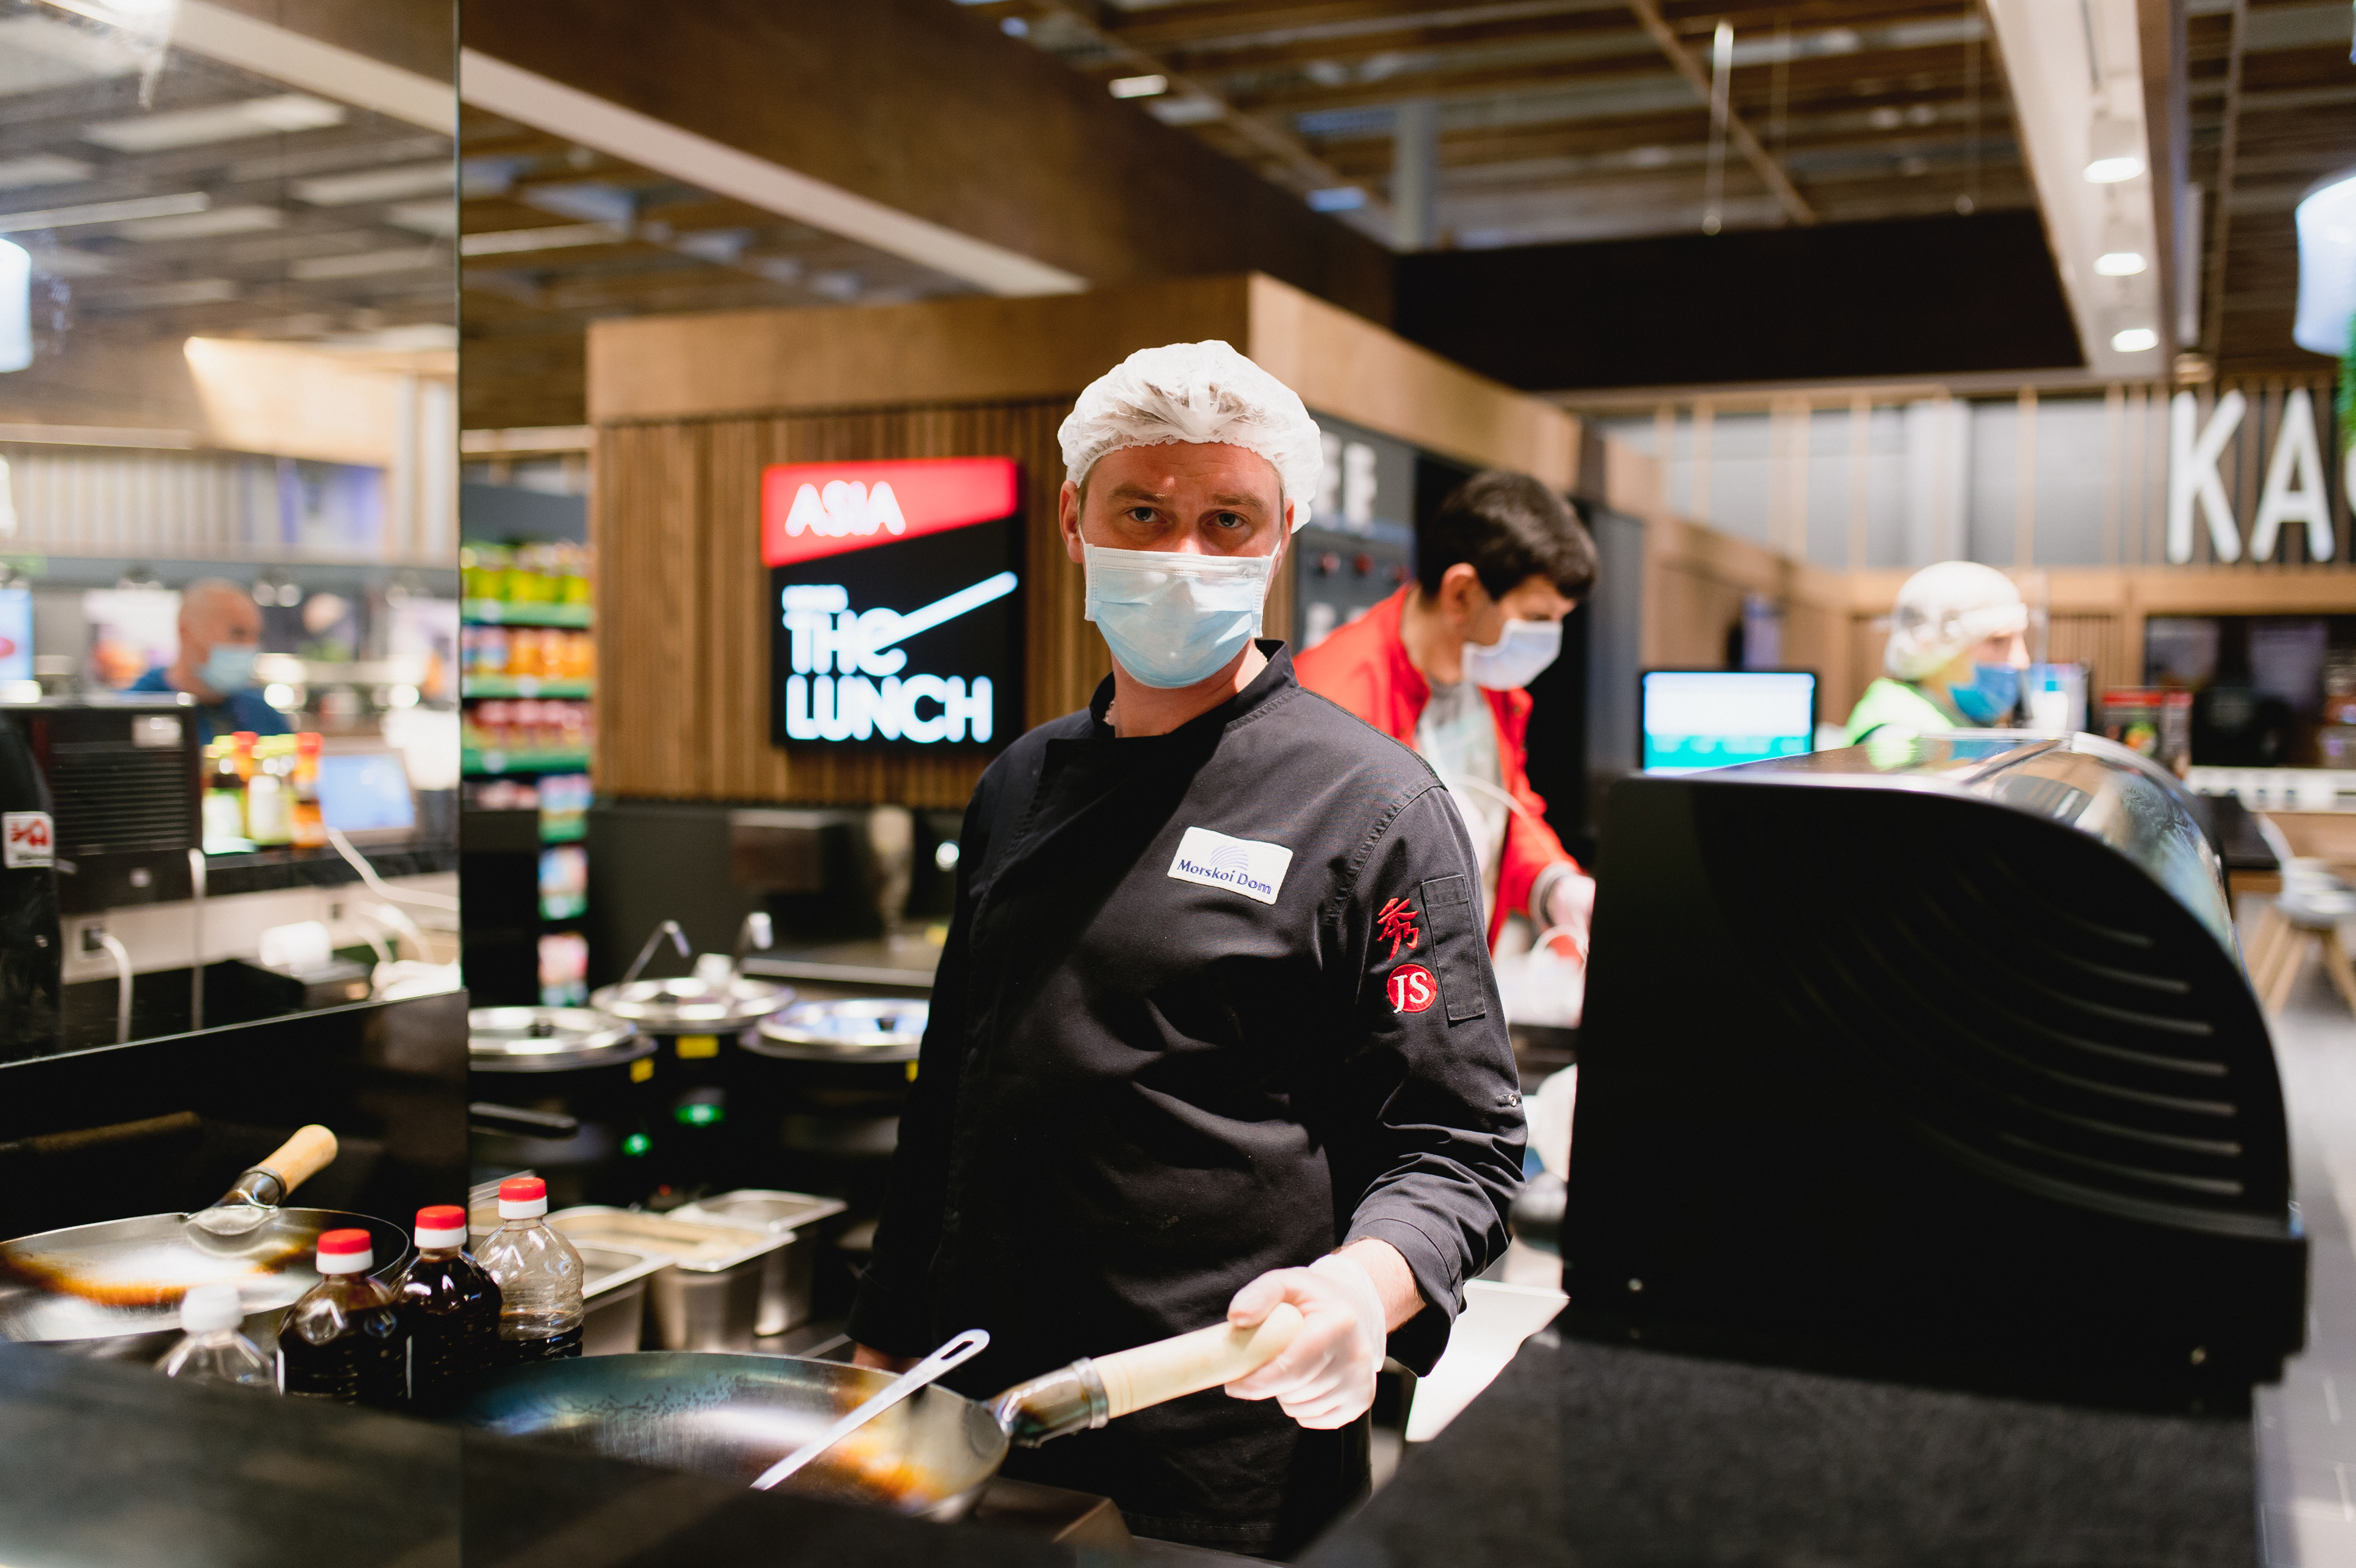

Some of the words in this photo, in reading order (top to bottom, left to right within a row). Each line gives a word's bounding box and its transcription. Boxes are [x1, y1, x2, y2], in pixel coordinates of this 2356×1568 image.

[785, 480, 906, 537] ASIA
[787, 674, 993, 743] LUNCH
[1177, 859, 1236, 882] Morskoi
[1237, 873, 1272, 895] Dom
[1393, 972, 1430, 1013] JS
